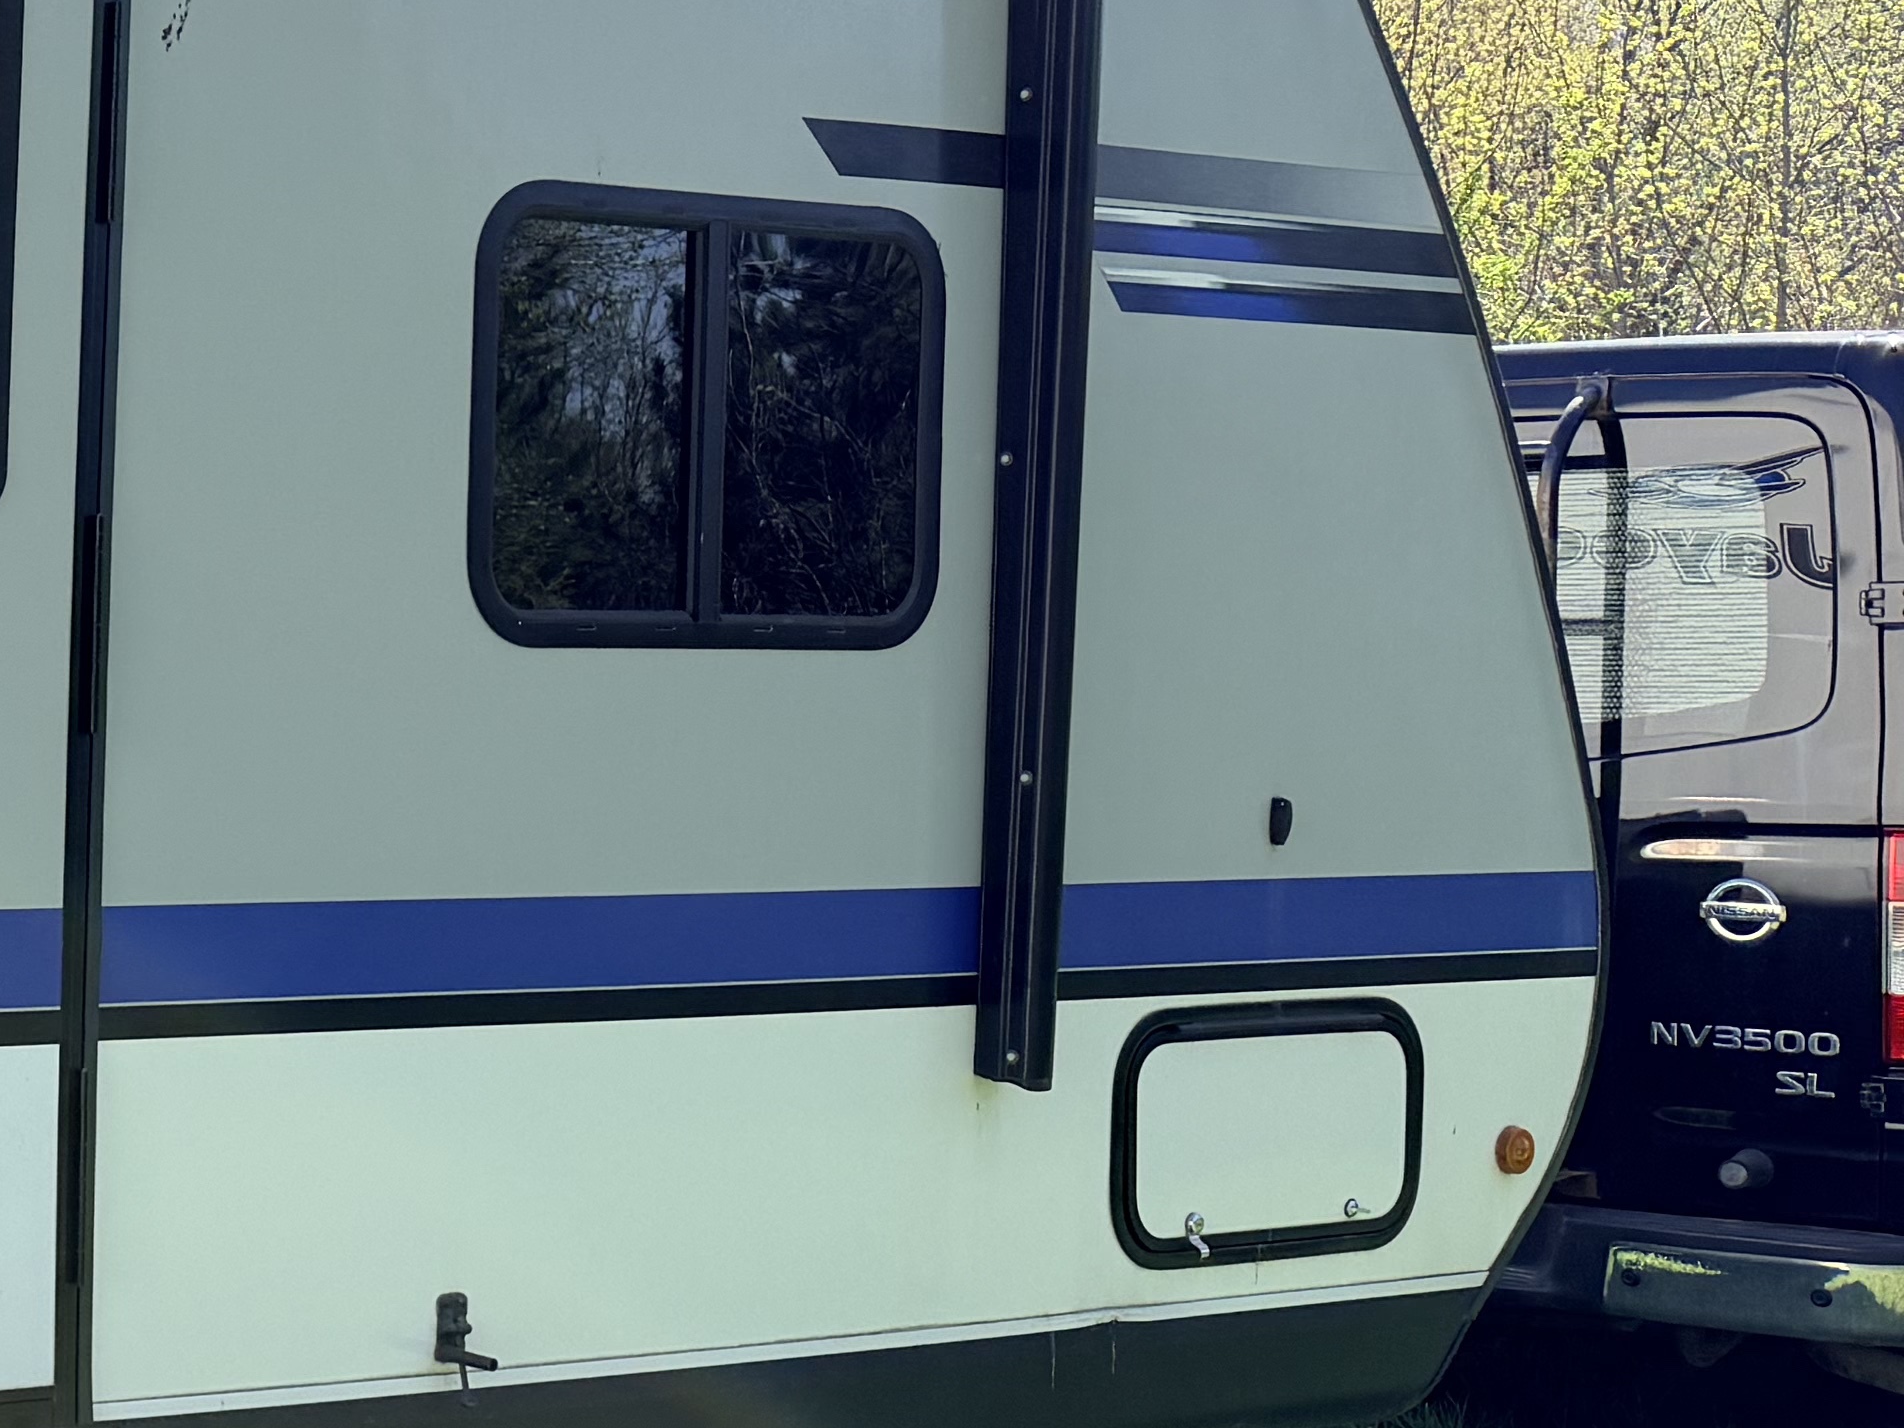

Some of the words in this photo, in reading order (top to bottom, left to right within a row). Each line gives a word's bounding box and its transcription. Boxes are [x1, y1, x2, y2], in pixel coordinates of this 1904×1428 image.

[1708, 905, 1777, 919] NISSAN
[1650, 1021, 1840, 1056] NV3500
[1775, 1071, 1835, 1098] SL
